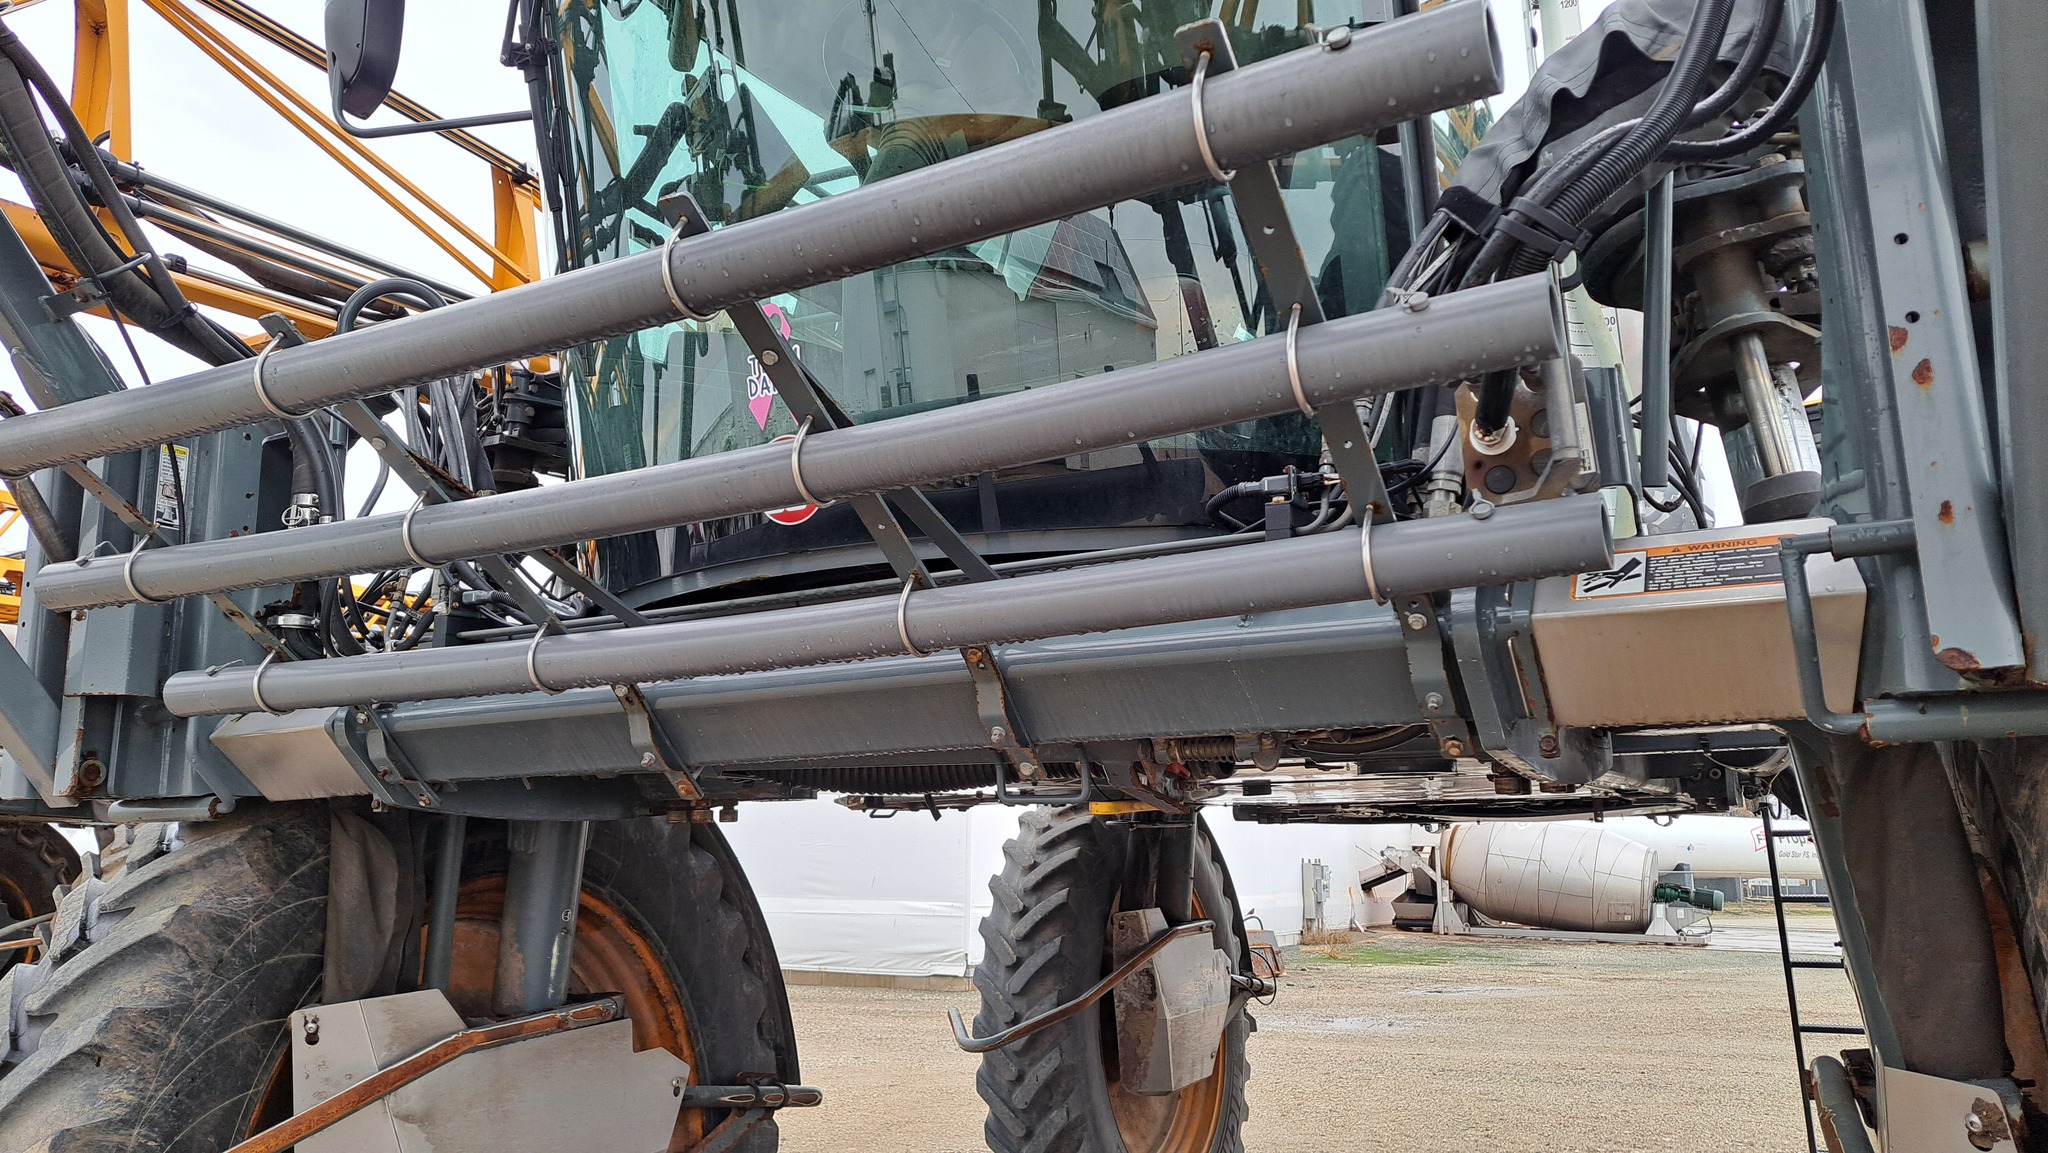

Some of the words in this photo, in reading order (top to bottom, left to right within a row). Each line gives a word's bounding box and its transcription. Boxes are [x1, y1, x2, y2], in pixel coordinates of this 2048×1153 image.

[1688, 539, 1759, 551] WARNING
[1779, 850, 1790, 858] Gold
[1791, 850, 1802, 858] Star
